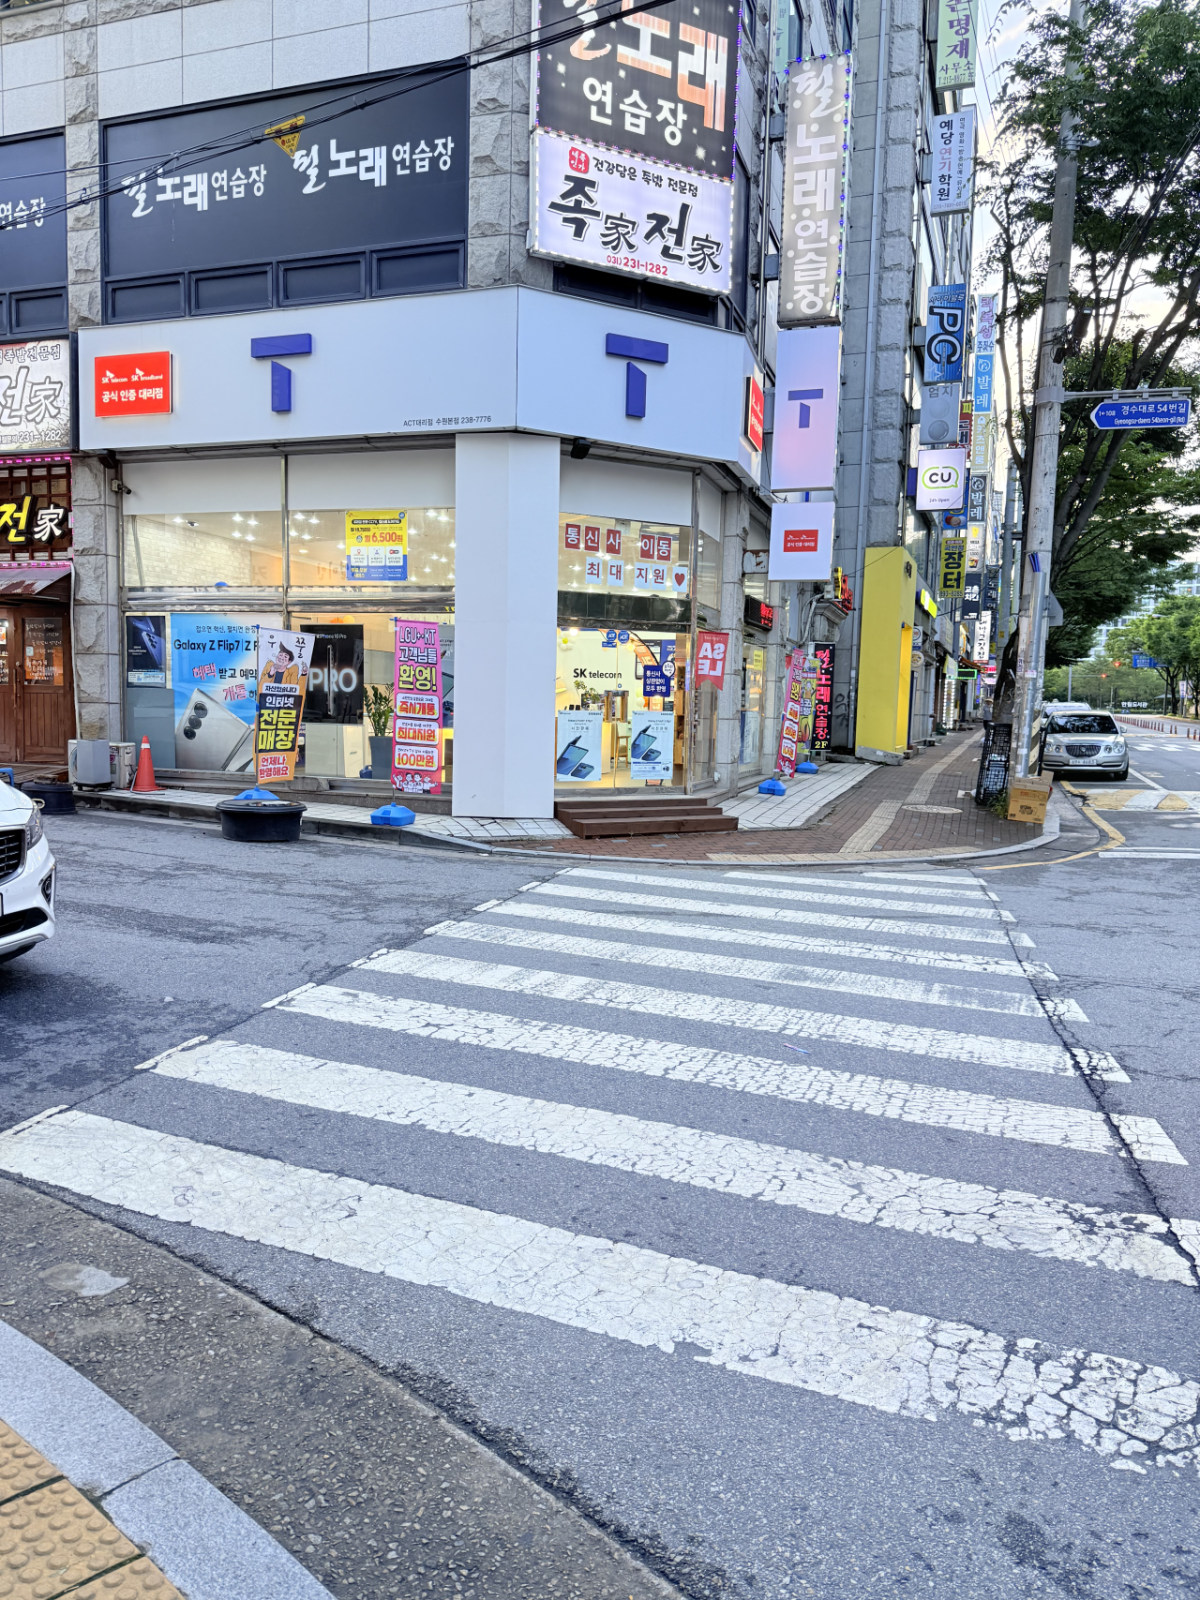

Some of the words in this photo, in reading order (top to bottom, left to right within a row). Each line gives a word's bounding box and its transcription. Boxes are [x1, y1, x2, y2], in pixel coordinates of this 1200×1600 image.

[939, 61, 973, 75] 사무소
[583, 77, 687, 146] 연습장
[329, 139, 387, 187] 노래
[392, 136, 454, 175] 연습장
[793, 124, 838, 212] 노래
[156, 167, 208, 212] 노래
[211, 164, 267, 201] 연습장
[667, 177, 698, 197] 전문점
[623, 258, 668, 277] 231-1282
[793, 218, 829, 315] 연습장
[927, 305, 964, 366] PC
[102, 390, 119, 403] 공식
[119, 388, 137, 402] 인증
[138, 387, 164, 400] 대리점
[928, 386, 953, 399] 엄지
[928, 471, 952, 484] CU
[565, 527, 621, 550] 통신사
[641, 538, 670, 556] 이동
[586, 562, 622, 580] 최대
[636, 567, 665, 584] 지원
[943, 551, 964, 589] 장터
[174, 639, 207, 653] Galaxy
[209, 640, 216, 651] Z
[217, 639, 240, 653] Flip7
[245, 640, 251, 651] Z
[399, 646, 437, 665] 고객님들
[192, 663, 217, 681] 혜택
[218, 668, 237, 680] 받고
[308, 667, 358, 693] PRO
[398, 664, 437, 691] 환영!
[573, 668, 587, 679] SK
[588, 670, 622, 679] telecom
[265, 696, 294, 708] 인터넷
[259, 709, 297, 730] 전문
[258, 729, 296, 751] 매장
[814, 741, 828, 749] 2F
[261, 756, 287, 768] 언제나
[397, 753, 434, 768] 100만원
